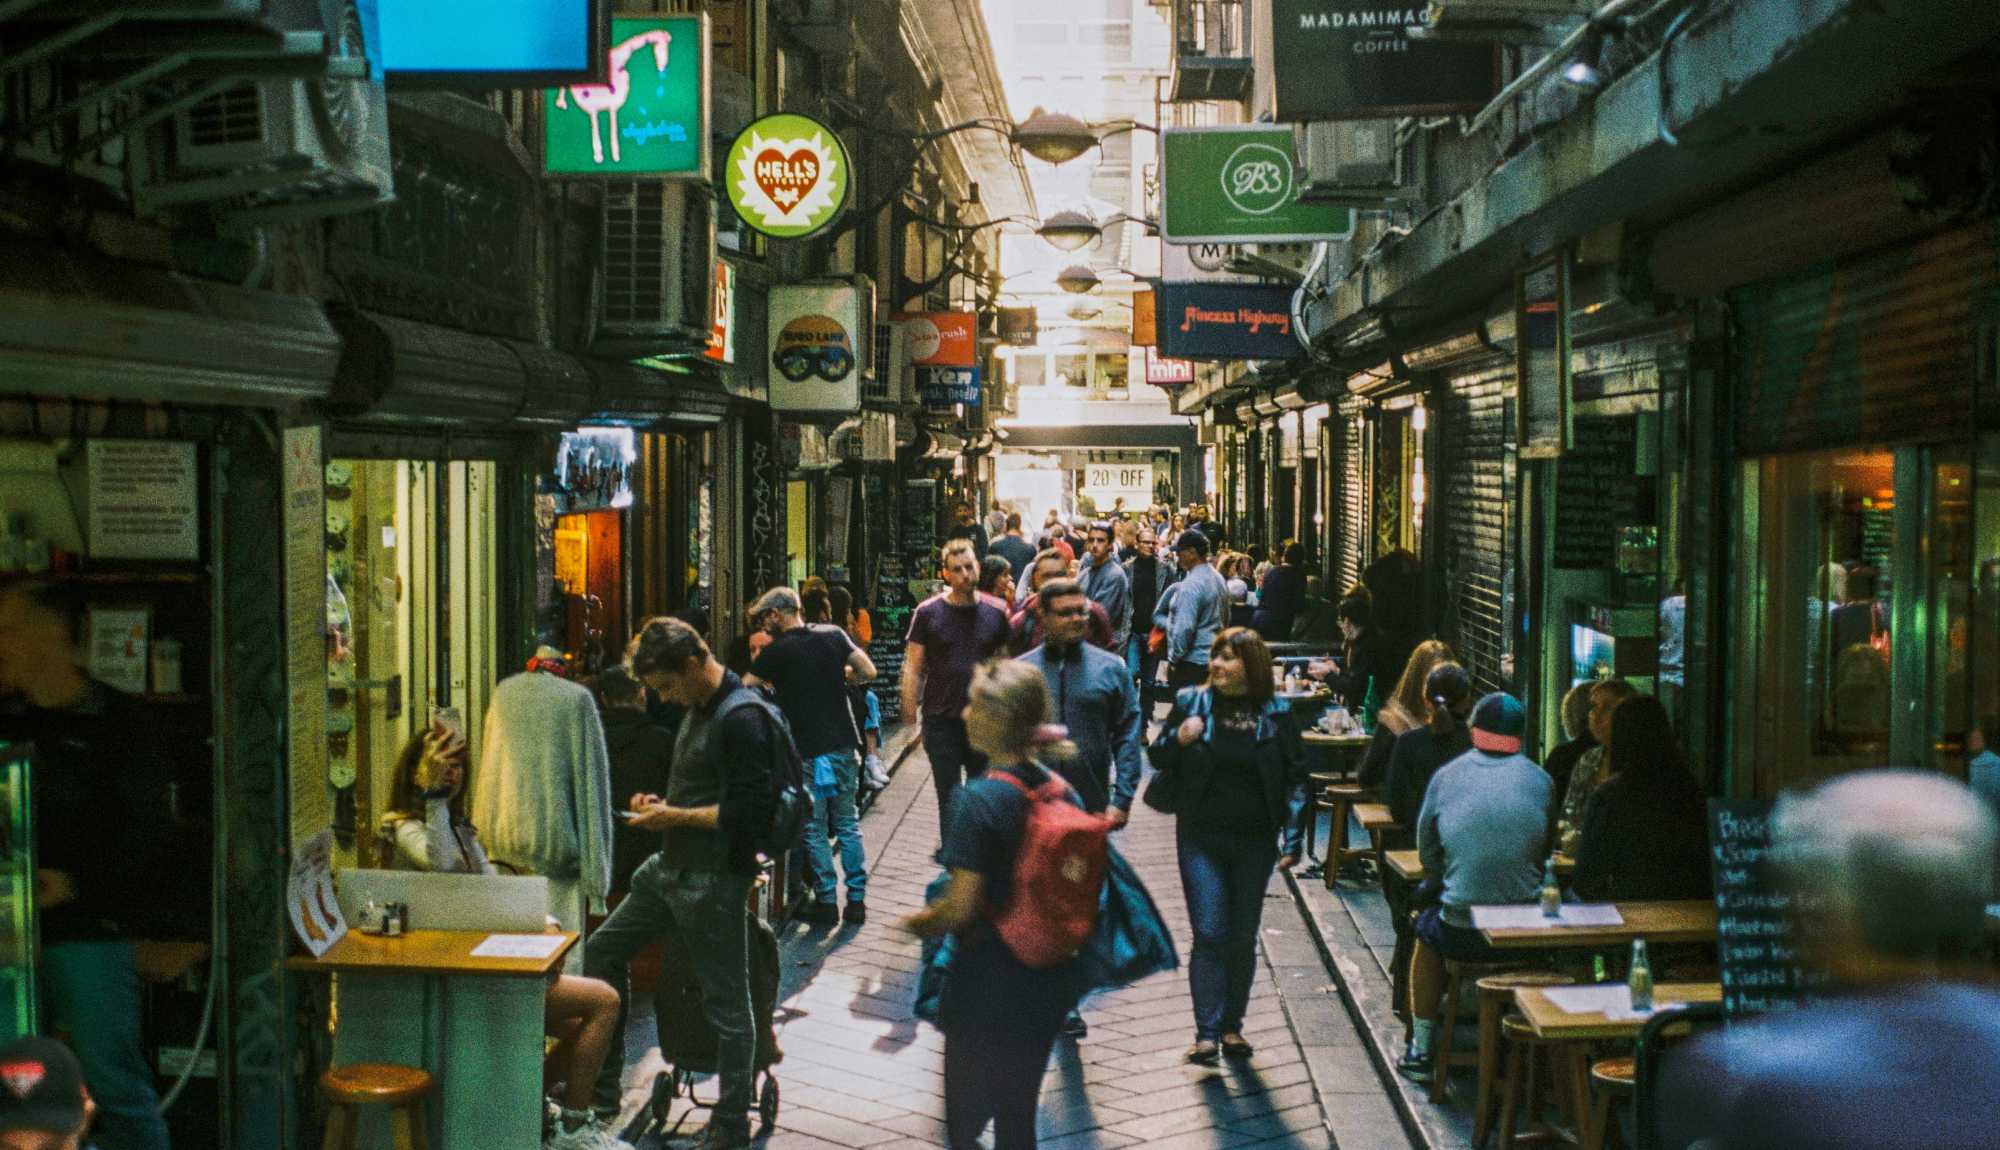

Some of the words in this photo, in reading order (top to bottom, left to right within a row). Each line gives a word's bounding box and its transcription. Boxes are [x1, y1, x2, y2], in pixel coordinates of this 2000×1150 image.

[1353, 39, 1408, 54] COFFEE
[757, 158, 817, 179] HELL'S
[1180, 304, 1235, 333] Princess
[1239, 308, 1289, 334] Highway
[1151, 359, 1189, 377] mini
[1120, 468, 1145, 487] OFF
